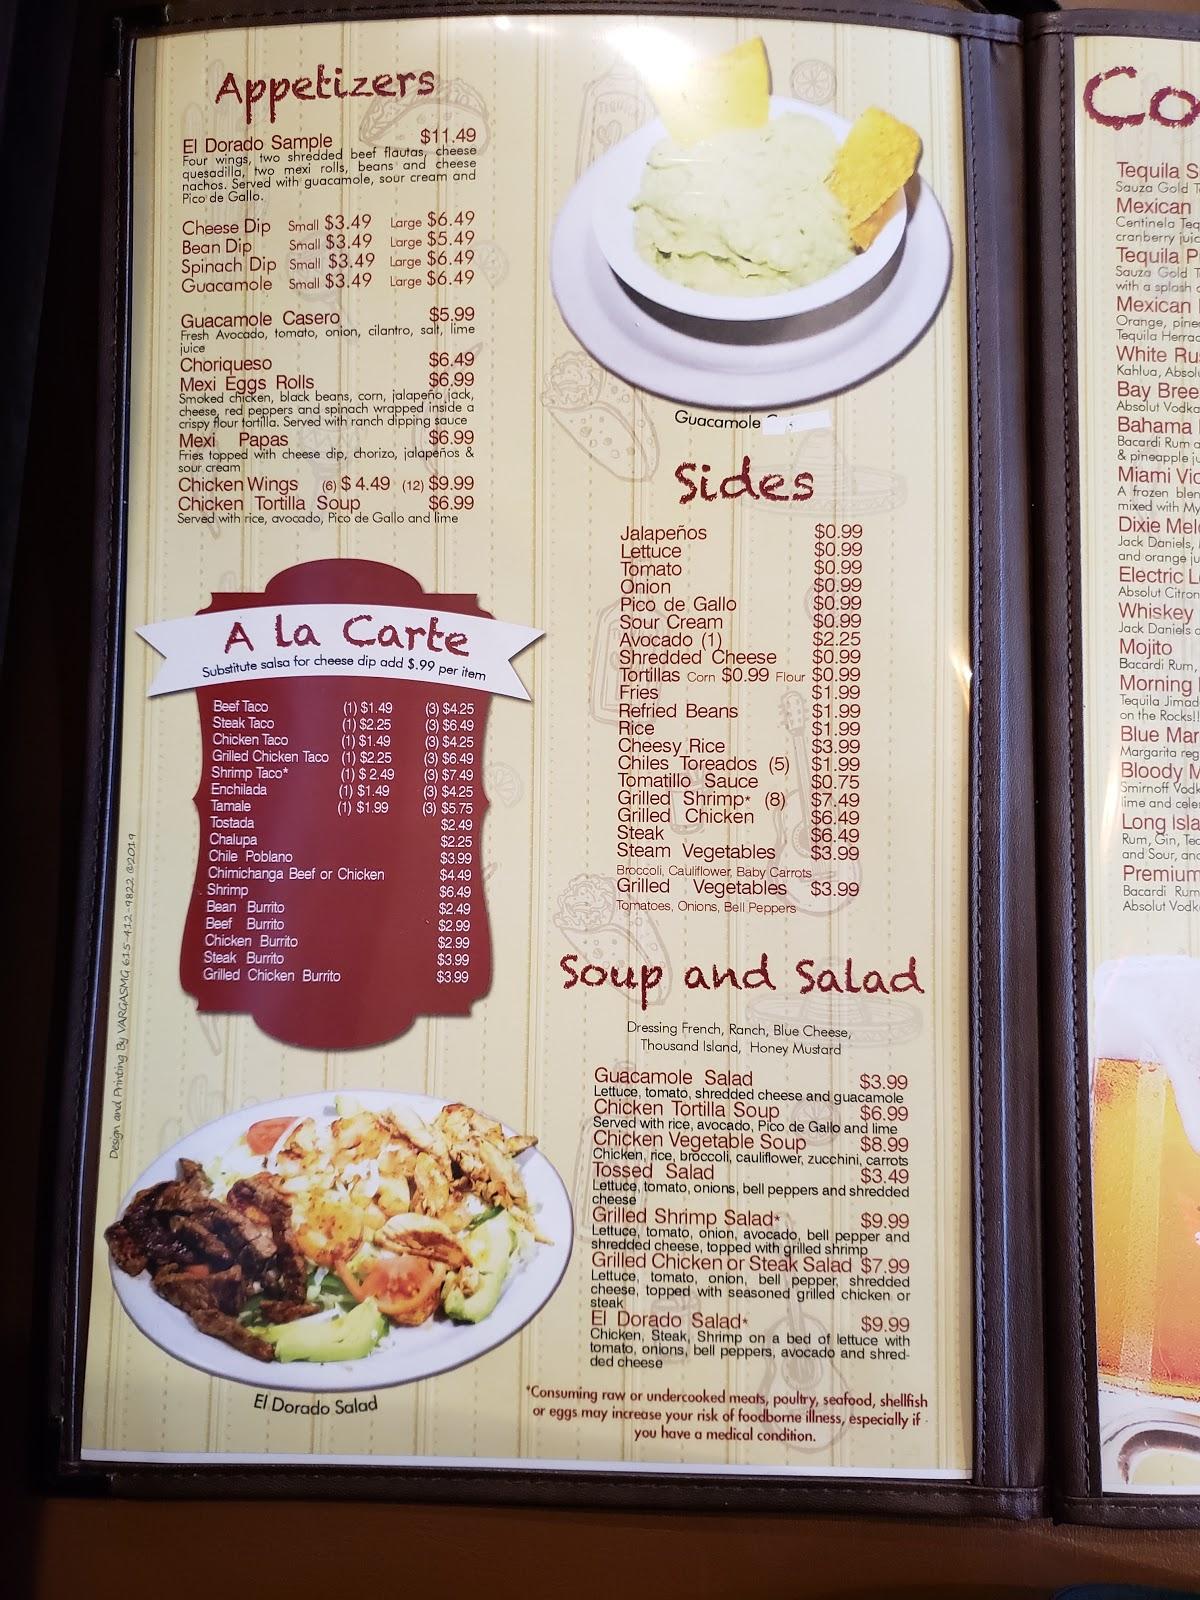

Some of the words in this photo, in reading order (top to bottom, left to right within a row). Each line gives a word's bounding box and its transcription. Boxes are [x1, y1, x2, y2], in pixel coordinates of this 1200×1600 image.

[215, 65, 435, 124] Appetizers
[183, 139, 197, 154] El
[205, 136, 263, 153] Dorado
[271, 133, 332, 154] Sample
[420, 127, 476, 146] $11.49
[182, 155, 208, 166] Four
[215, 153, 251, 167] wings,
[259, 152, 280, 163] two
[287, 150, 343, 162] shredded
[350, 149, 376, 160] beef
[383, 147, 426, 160] flautas,
[435, 145, 477, 157] cheese
[1117, 162, 1180, 182] Tequila
[1116, 181, 1153, 192] Sauza
[1158, 182, 1188, 193] Gold
[1117, 198, 1191, 214] Mexican
[182, 219, 239, 236] Cheese
[244, 218, 270, 238] Dip
[288, 219, 318, 232] Small
[324, 212, 371, 231] $3.49
[390, 217, 422, 231] Large
[427, 209, 475, 228] $6.49
[180, 312, 272, 328] Guacamole
[282, 311, 340, 326] Casero
[429, 305, 474, 323] $5.99
[180, 329, 209, 341] Fresh
[215, 328, 267, 341] Avocado,
[274, 327, 317, 340] tomato,
[325, 326, 360, 339] onion,
[368, 325, 413, 338] cilantro,
[420, 324, 442, 337] salt,
[450, 324, 475, 335] lime
[180, 356, 272, 375] Choriqueso
[428, 351, 474, 369] $6.49
[1116, 346, 1167, 362] White
[180, 377, 215, 391] Mexi
[225, 376, 266, 394] Eggs
[276, 376, 314, 390] Rolls
[428, 371, 474, 388] $6.99
[1117, 381, 1150, 401] Bay
[675, 410, 761, 429] Guacamole
[1118, 416, 1192, 434] Bahama
[674, 456, 814, 504] Sides
[178, 496, 244, 511] Chicken
[254, 496, 306, 511] Tortilla
[316, 496, 360, 514] Soup
[428, 494, 474, 511] $6.99
[620, 526, 706, 544] Jalapeños
[814, 524, 862, 540] $0.99
[1119, 516, 1162, 533] Dixie
[1120, 567, 1184, 583] Electric
[1119, 586, 1161, 597] Absolut
[1165, 587, 1200, 598] Citron
[620, 598, 655, 612] Pico
[663, 598, 685, 612] de
[693, 598, 736, 611] Gallo
[813, 595, 862, 612] $0.99
[1119, 602, 1194, 624] Whiskey
[224, 622, 254, 654] A
[275, 614, 320, 647] la
[342, 615, 469, 657] Carte
[619, 633, 693, 647] Avocado
[701, 633, 722, 650] (1)
[812, 631, 860, 648] $2.25
[1120, 639, 1172, 659] Mojito
[202, 659, 258, 678] Substitute
[260, 657, 290, 670] salsa
[293, 654, 311, 668] for
[314, 654, 354, 667] cheese
[358, 655, 377, 671] dip
[381, 656, 404, 669] add
[407, 657, 435, 673] $.99
[438, 665, 458, 677] per
[462, 667, 486, 681] item
[1120, 658, 1164, 670] Bacardi
[1169, 659, 1197, 672] Rum,
[213, 700, 240, 712] Beef
[241, 700, 268, 712] Taco
[343, 701, 357, 717] (1)
[360, 701, 392, 716] $1.49
[425, 702, 439, 718] (3)
[442, 702, 474, 716] $4.25
[212, 750, 248, 762] Grilled
[252, 750, 298, 763] Chicken
[302, 751, 329, 763] Taco
[341, 751, 356, 766] (1)
[359, 750, 392, 765] $2.25
[423, 751, 438, 767] (3)
[441, 751, 473, 766] $6.49
[617, 773, 691, 788] Tomatillo
[704, 773, 758, 788] Sauce
[810, 774, 859, 791] $0.75
[209, 833, 257, 849] Chalupa
[440, 834, 472, 849] $2.25
[616, 844, 670, 858] Steam
[682, 844, 775, 862] Vegetables
[810, 845, 859, 862] $3.99
[208, 867, 283, 883] Chimichanga
[288, 868, 315, 880] Beef
[319, 871, 333, 880] or
[337, 868, 384, 880] Chicken
[439, 868, 471, 882] $4.49
[616, 865, 664, 877] Broccoli,
[668, 866, 732, 878] Cauliflower,
[736, 867, 766, 880] Baby
[769, 867, 812, 878] Carrots
[1124, 865, 1200, 881] Premium
[203, 952, 237, 964] Steak
[246, 952, 284, 964] Burrito
[437, 952, 469, 967] $3.99
[560, 954, 663, 1011] Soup
[684, 953, 776, 990] and
[795, 957, 925, 994] Salad
[627, 1021, 677, 1037] Dressing
[682, 1022, 724, 1036] French,
[729, 1023, 768, 1037] Ranch,
[773, 1024, 799, 1037] Blue
[802, 1025, 851, 1039] Cheese,
[594, 1069, 692, 1085] Guacamole
[704, 1070, 752, 1086] Salad
[859, 1073, 908, 1091] $3.99
[594, 1086, 641, 1100] Lettuce,
[644, 1087, 691, 1101] tomato,
[694, 1088, 754, 1100] shredded
[757, 1089, 802, 1101] cheese
[805, 1090, 830, 1102] and
[833, 1091, 904, 1106] guacamole
[591, 1311, 606, 1327] El
[617, 1311, 681, 1328] Dorado
[860, 1315, 910, 1334] $9.99
[254, 1394, 268, 1409] El
[272, 1397, 330, 1415] Dorado
[335, 1395, 378, 1414] Salad
[602, 1390, 626, 1400] raw
[629, 1391, 643, 1401] or
[646, 1388, 725, 1403] undercooked
[729, 1390, 769, 1406] meats,
[773, 1391, 819, 1408] poultry,
[823, 1392, 875, 1408] seafood,
[880, 1393, 928, 1407] shellfish
